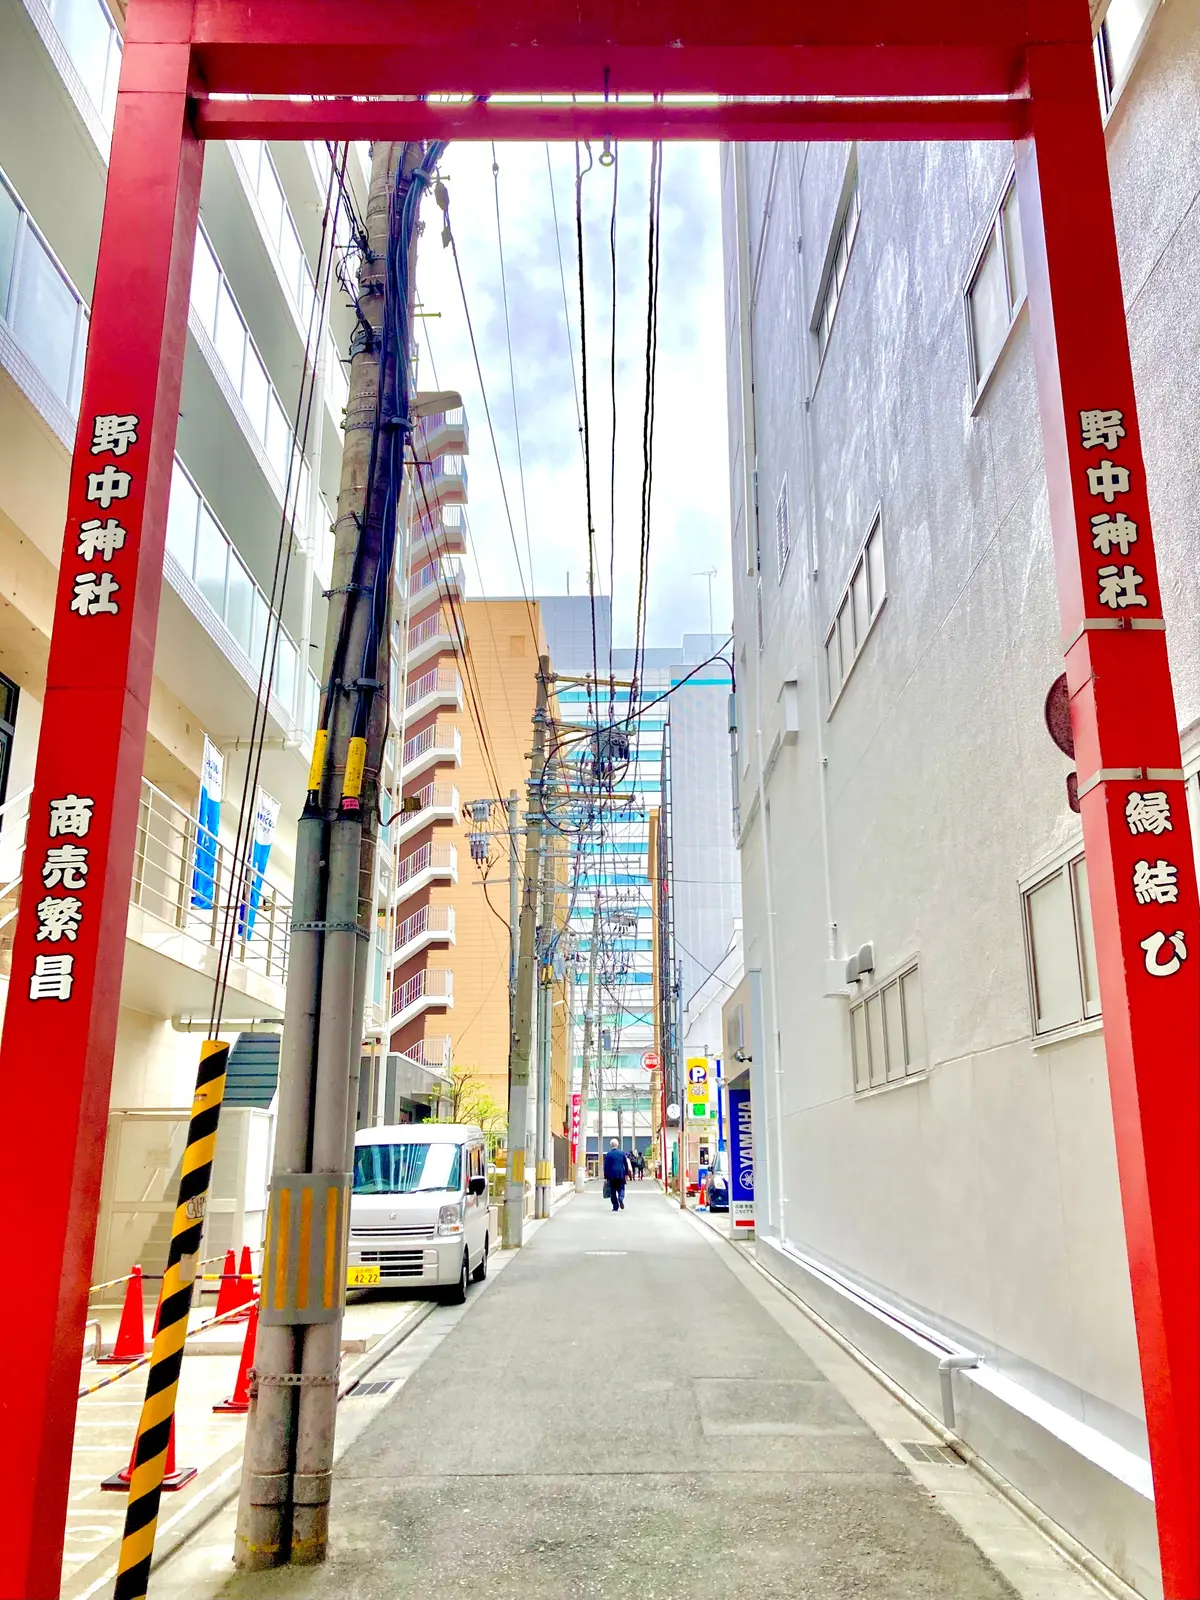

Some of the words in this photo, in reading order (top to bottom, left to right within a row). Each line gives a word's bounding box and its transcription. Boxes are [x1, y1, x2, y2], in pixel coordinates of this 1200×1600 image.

[70, 413, 139, 617] 野中神社
[1079, 408, 1148, 610] 野中神社
[28, 794, 95, 1002] 商売繁昌
[1125, 790, 1188, 978] 縁結び
[737, 1101, 754, 1169] YAMAHA
[354, 1274, 379, 1284] 42-22
